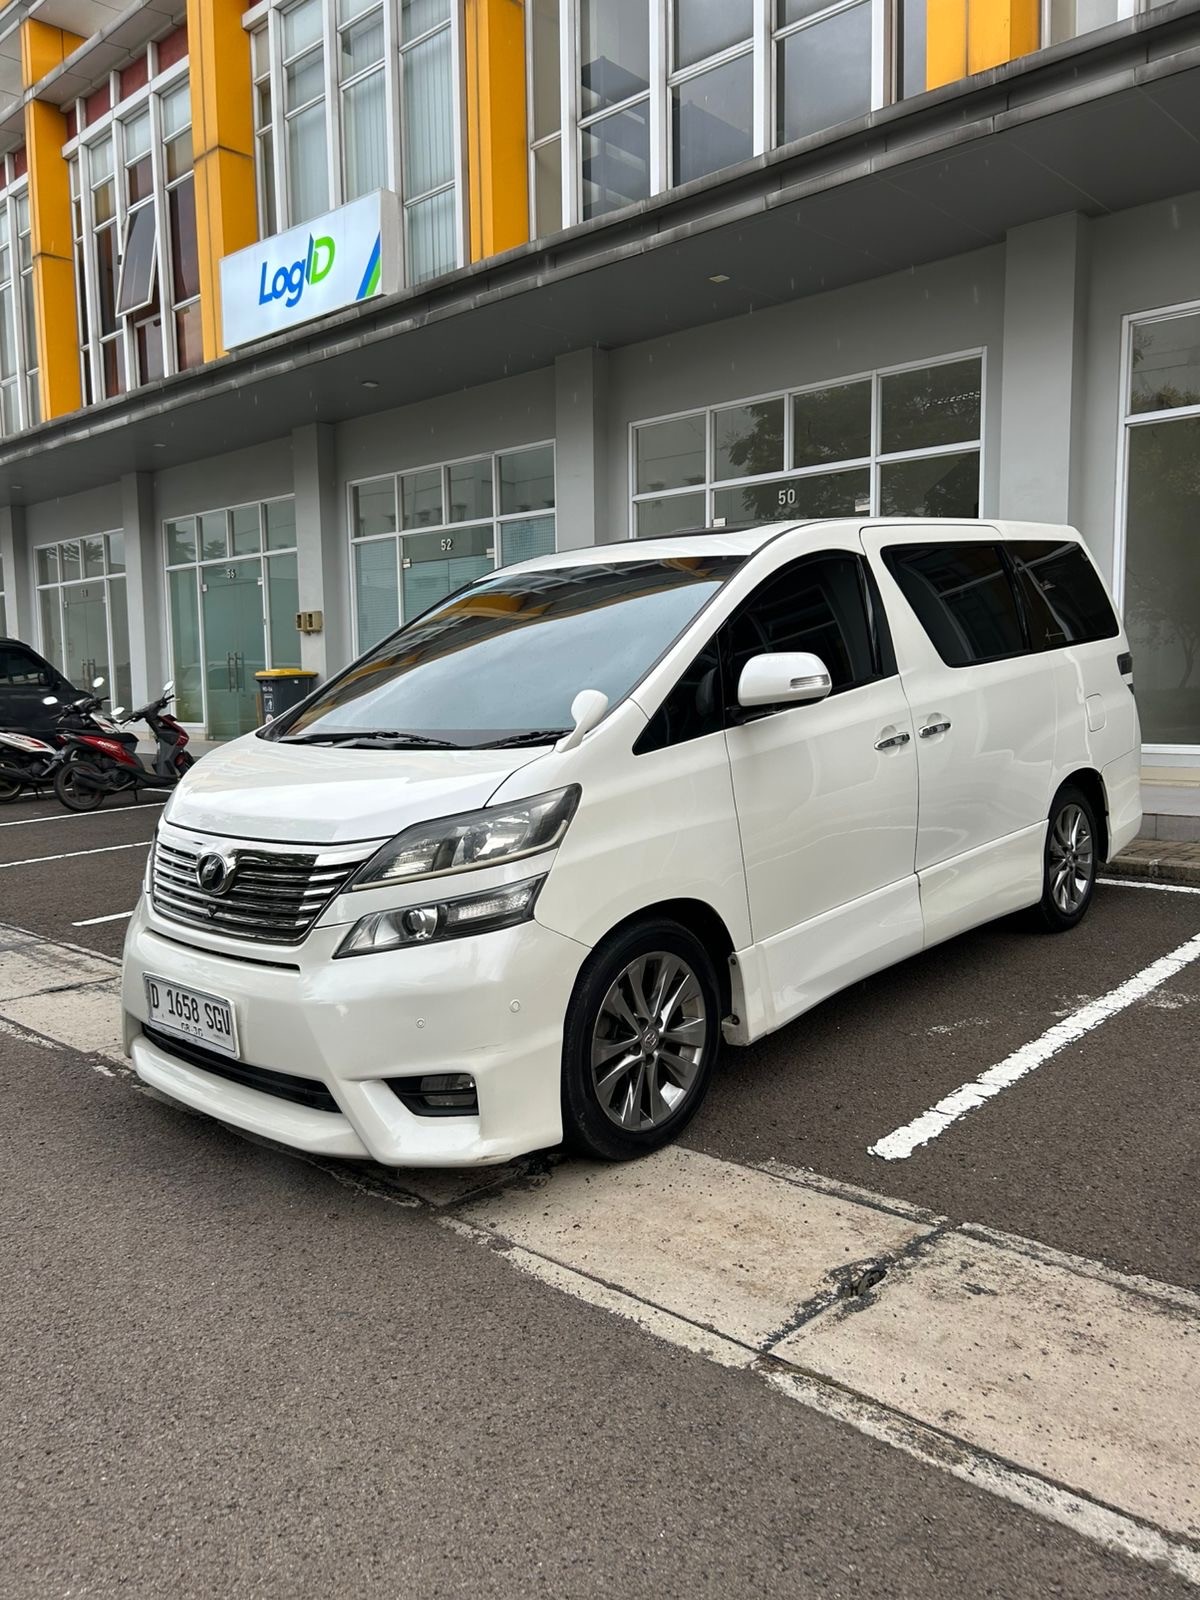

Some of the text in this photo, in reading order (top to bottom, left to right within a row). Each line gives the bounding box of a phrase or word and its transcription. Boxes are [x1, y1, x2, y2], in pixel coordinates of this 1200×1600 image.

[259, 232, 335, 308] LogID
[778, 489, 796, 505] 50
[441, 538, 453, 551] 52
[150, 983, 160, 1009] D
[167, 989, 200, 1024] 1658
